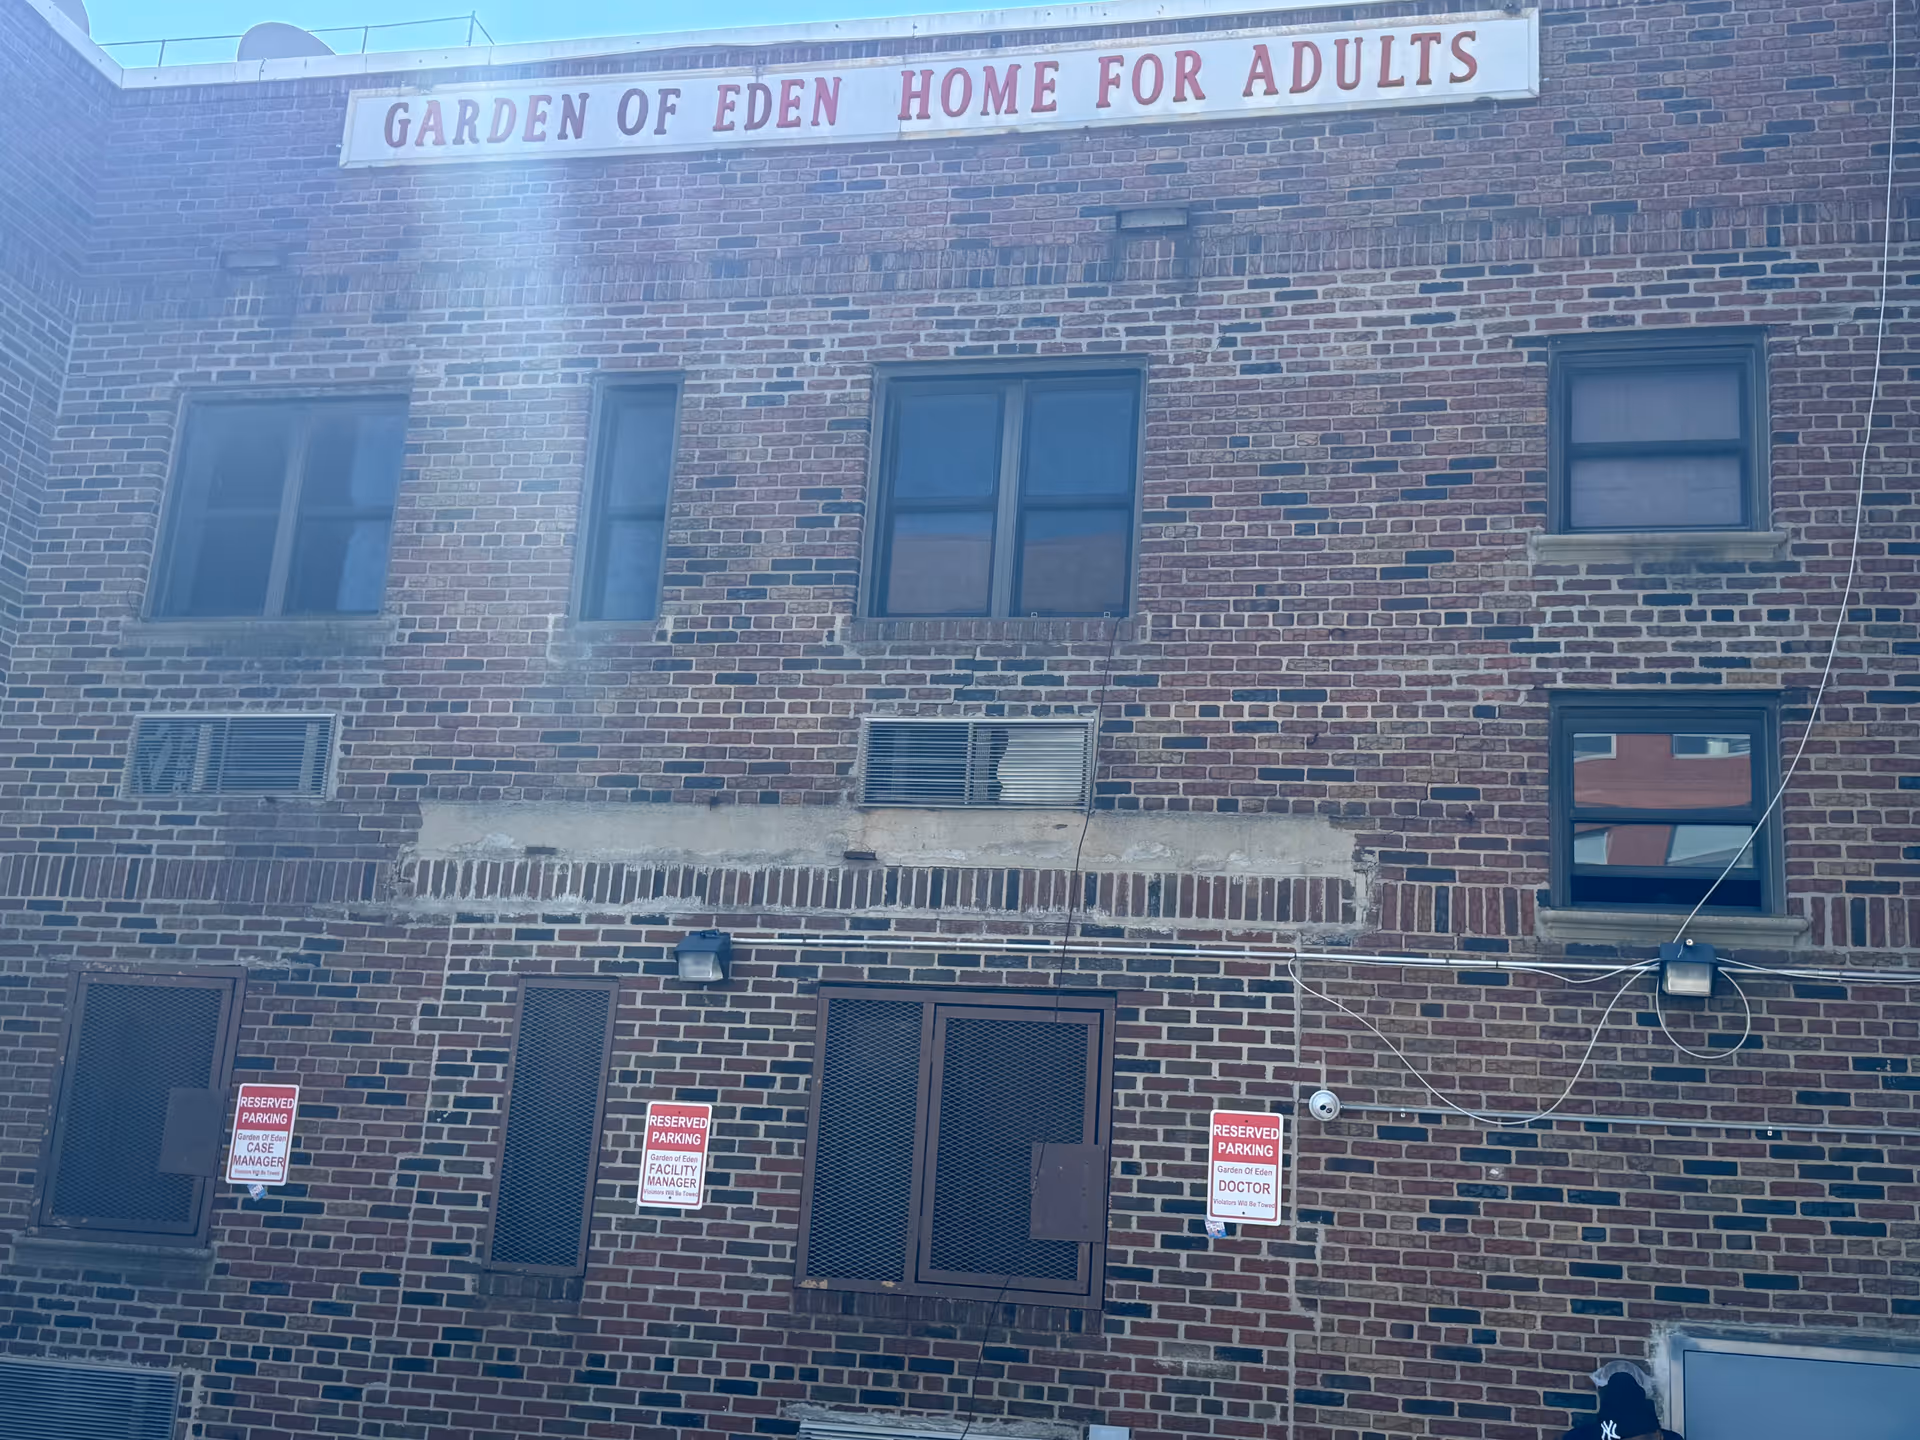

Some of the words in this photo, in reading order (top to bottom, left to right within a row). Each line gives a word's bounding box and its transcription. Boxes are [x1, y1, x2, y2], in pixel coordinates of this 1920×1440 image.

[384, 92, 590, 148] GARDEN
[617, 88, 681, 136] OF
[713, 77, 842, 132] EDEN
[898, 60, 1060, 120] HOME
[1096, 50, 1206, 108] FOR
[1243, 30, 1478, 97] ADULTS
[240, 1097, 295, 1109] RESERVED
[242, 1112, 288, 1124] PARKING
[649, 1115, 708, 1129] RESERVED
[651, 1131, 701, 1145] PARKING
[1214, 1124, 1279, 1140] RESERVED
[247, 1142, 274, 1153] CASE
[1218, 1142, 1274, 1157] PARKING
[233, 1155, 285, 1167] MANAGER
[650, 1154, 673, 1162] Garden
[682, 1155, 698, 1163] Eden
[649, 1163, 697, 1176] FACILITY
[1217, 1166, 1242, 1174] Garden
[1244, 1166, 1254, 1175] Of
[1254, 1167, 1273, 1176] Eden
[647, 1176, 697, 1188] MANAGER
[1219, 1180, 1271, 1194] DOCTOR
